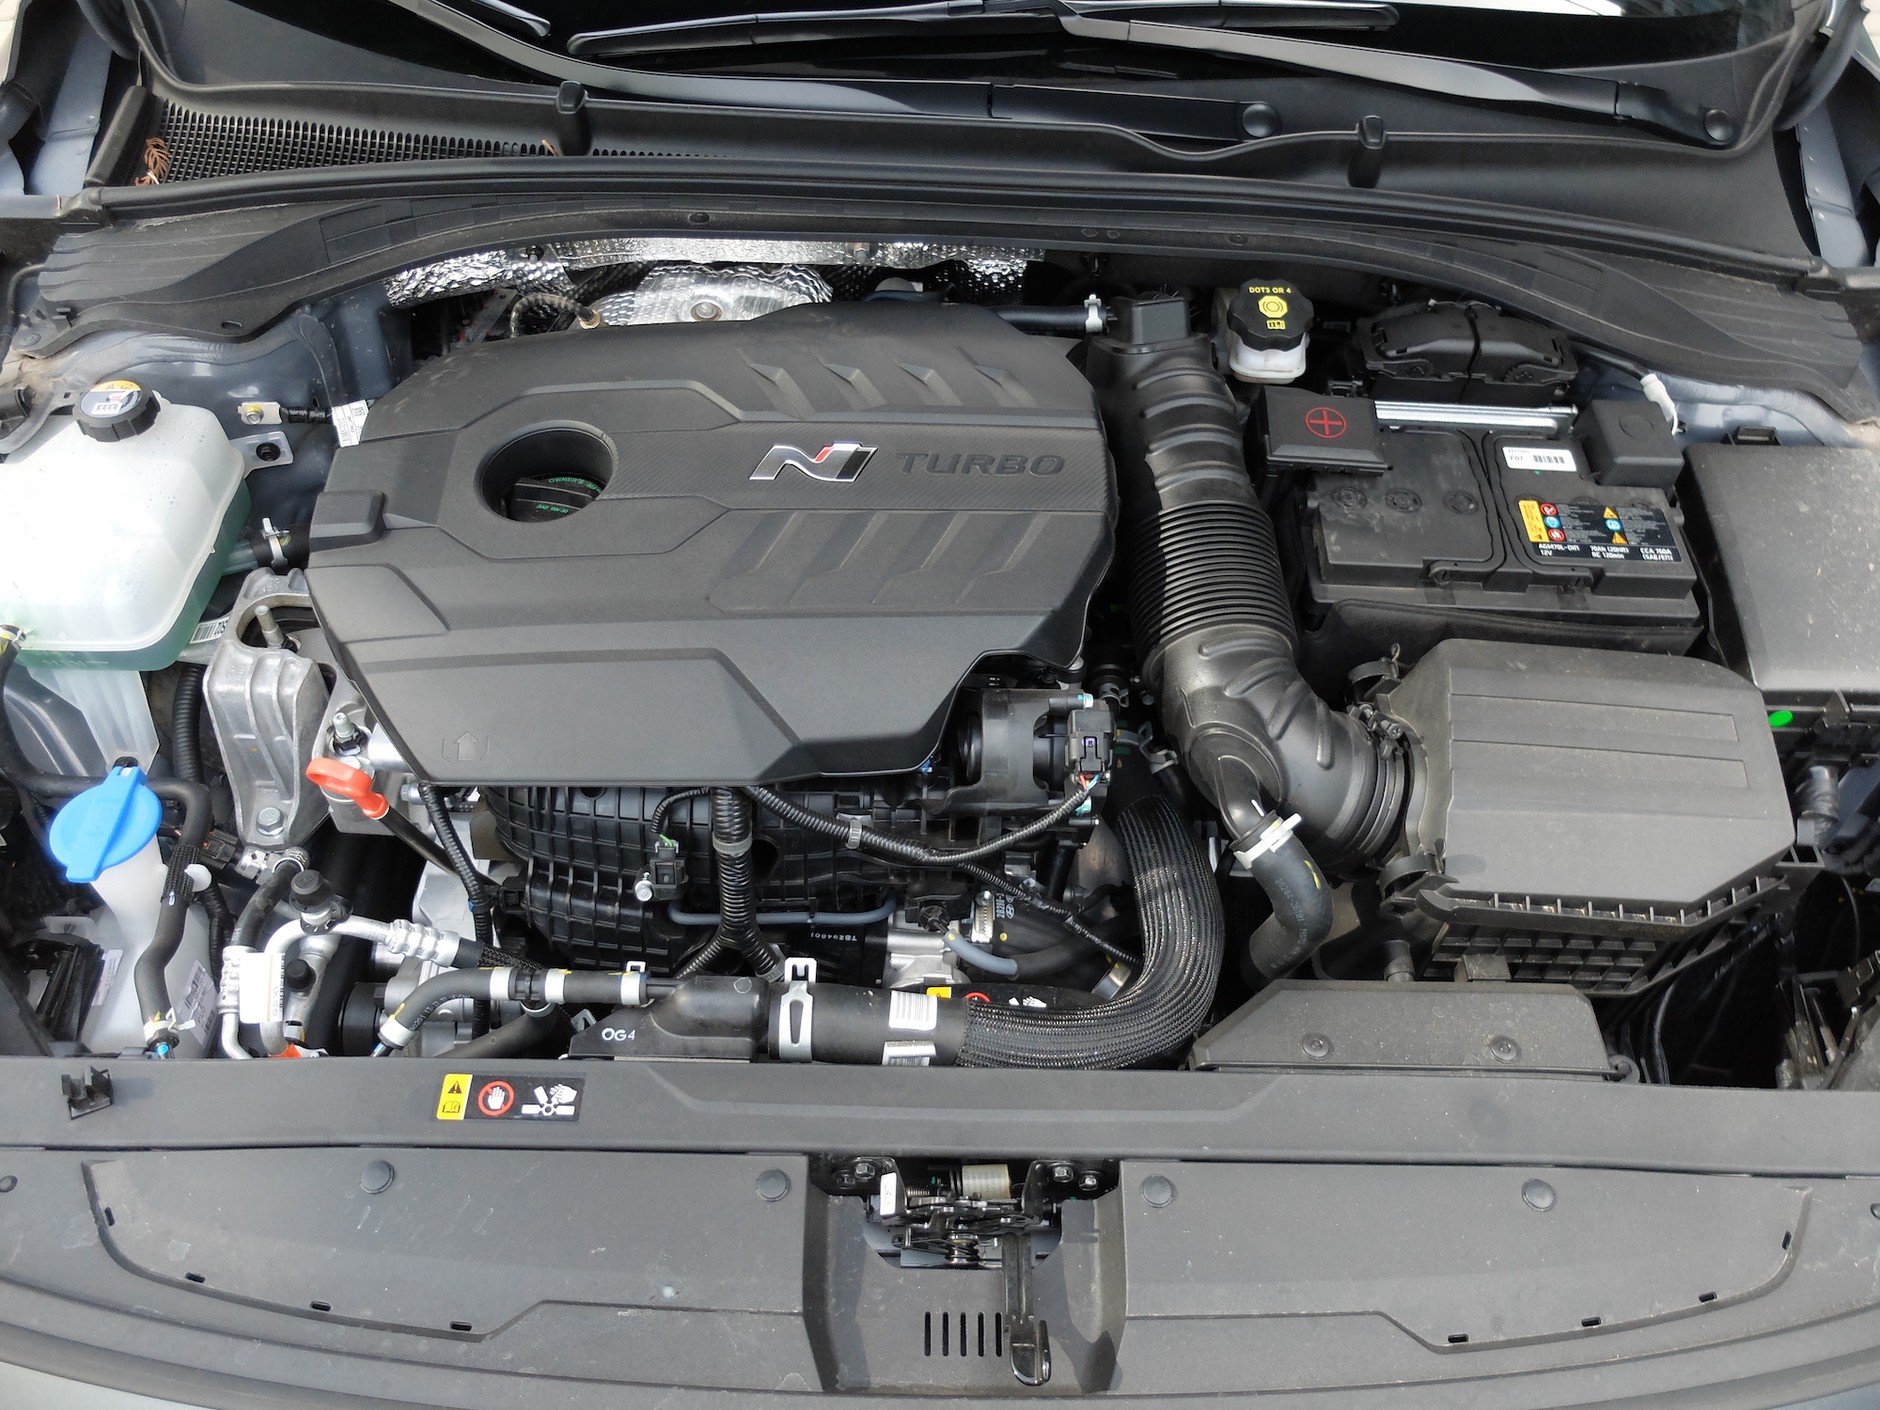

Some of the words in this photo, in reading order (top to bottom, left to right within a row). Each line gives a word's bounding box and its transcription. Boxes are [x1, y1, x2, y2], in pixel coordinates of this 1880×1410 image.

[1248, 286, 1270, 294] DOT3
[1272, 286, 1284, 294] OR
[897, 452, 1066, 478] TURBO
